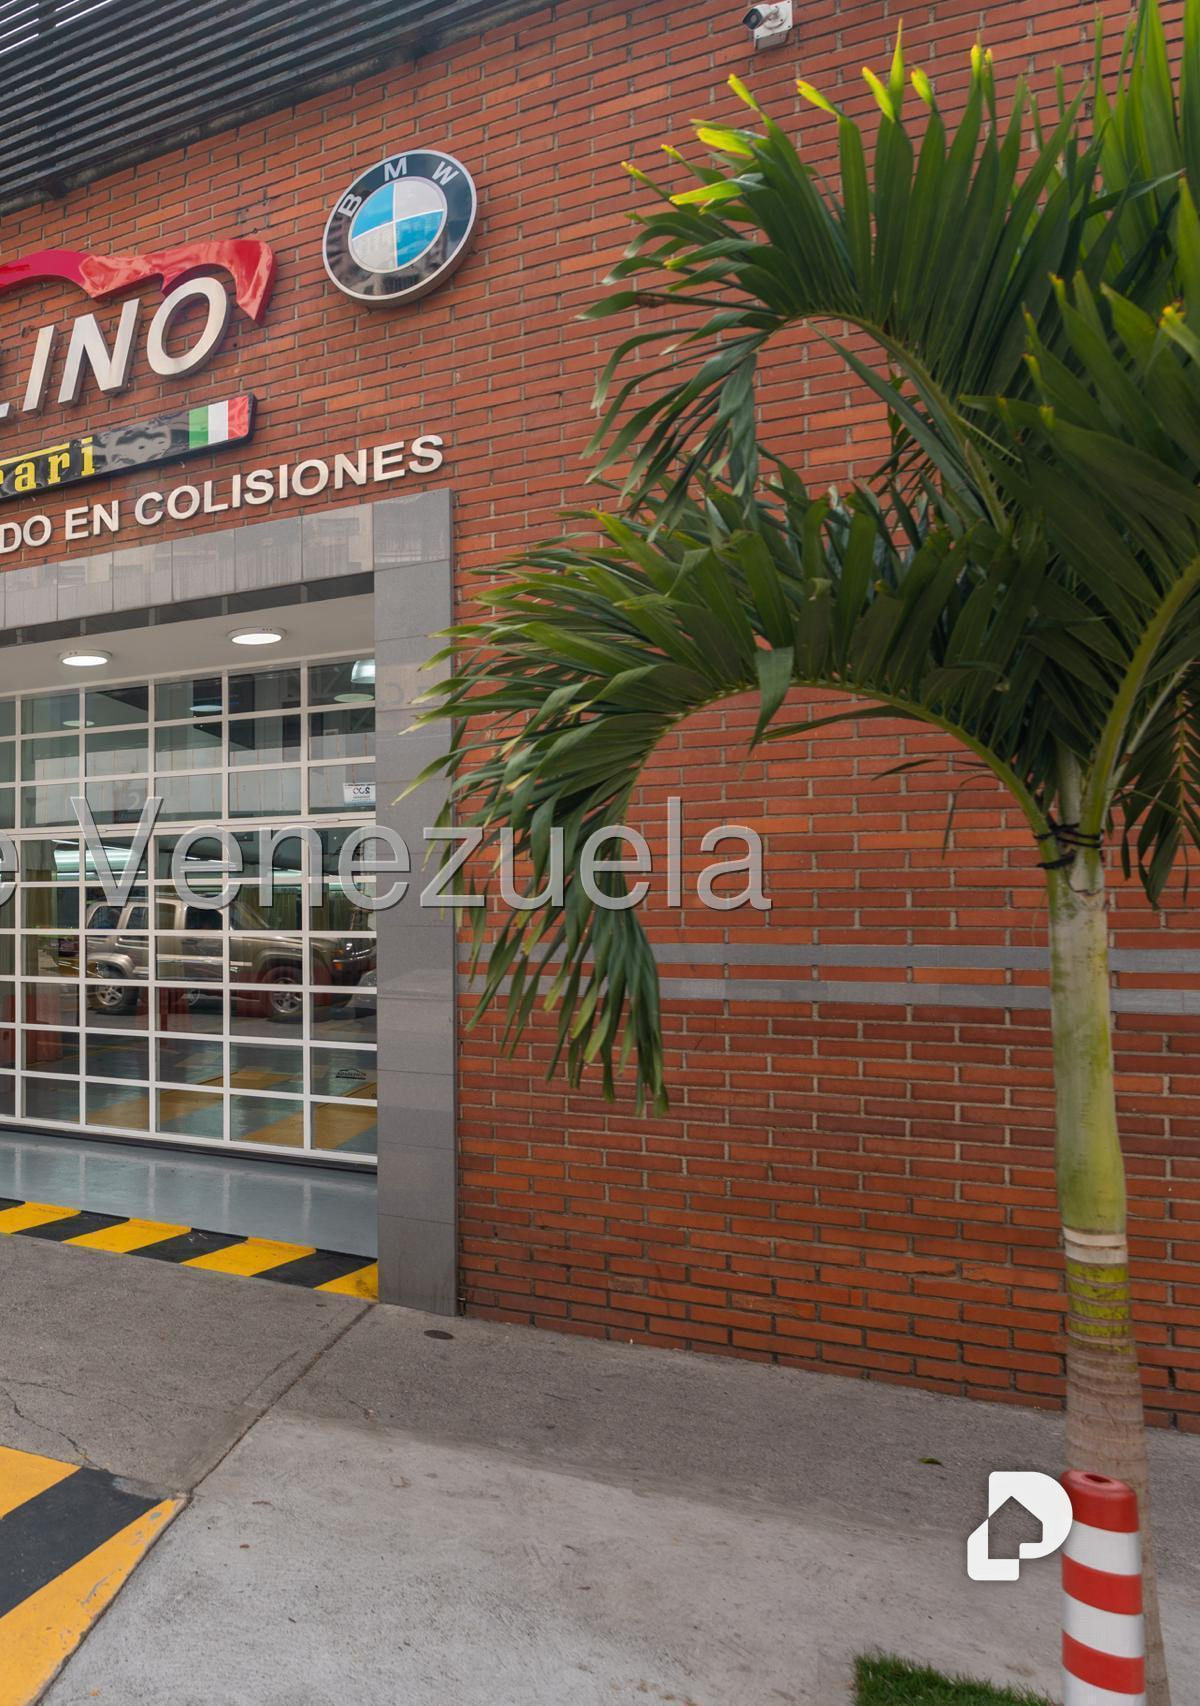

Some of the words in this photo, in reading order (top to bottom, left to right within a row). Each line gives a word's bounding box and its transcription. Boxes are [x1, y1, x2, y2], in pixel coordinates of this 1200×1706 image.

[337, 157, 457, 217] BMW
[64, 500, 118, 541] EN
[134, 435, 444, 525] COLISIONES
